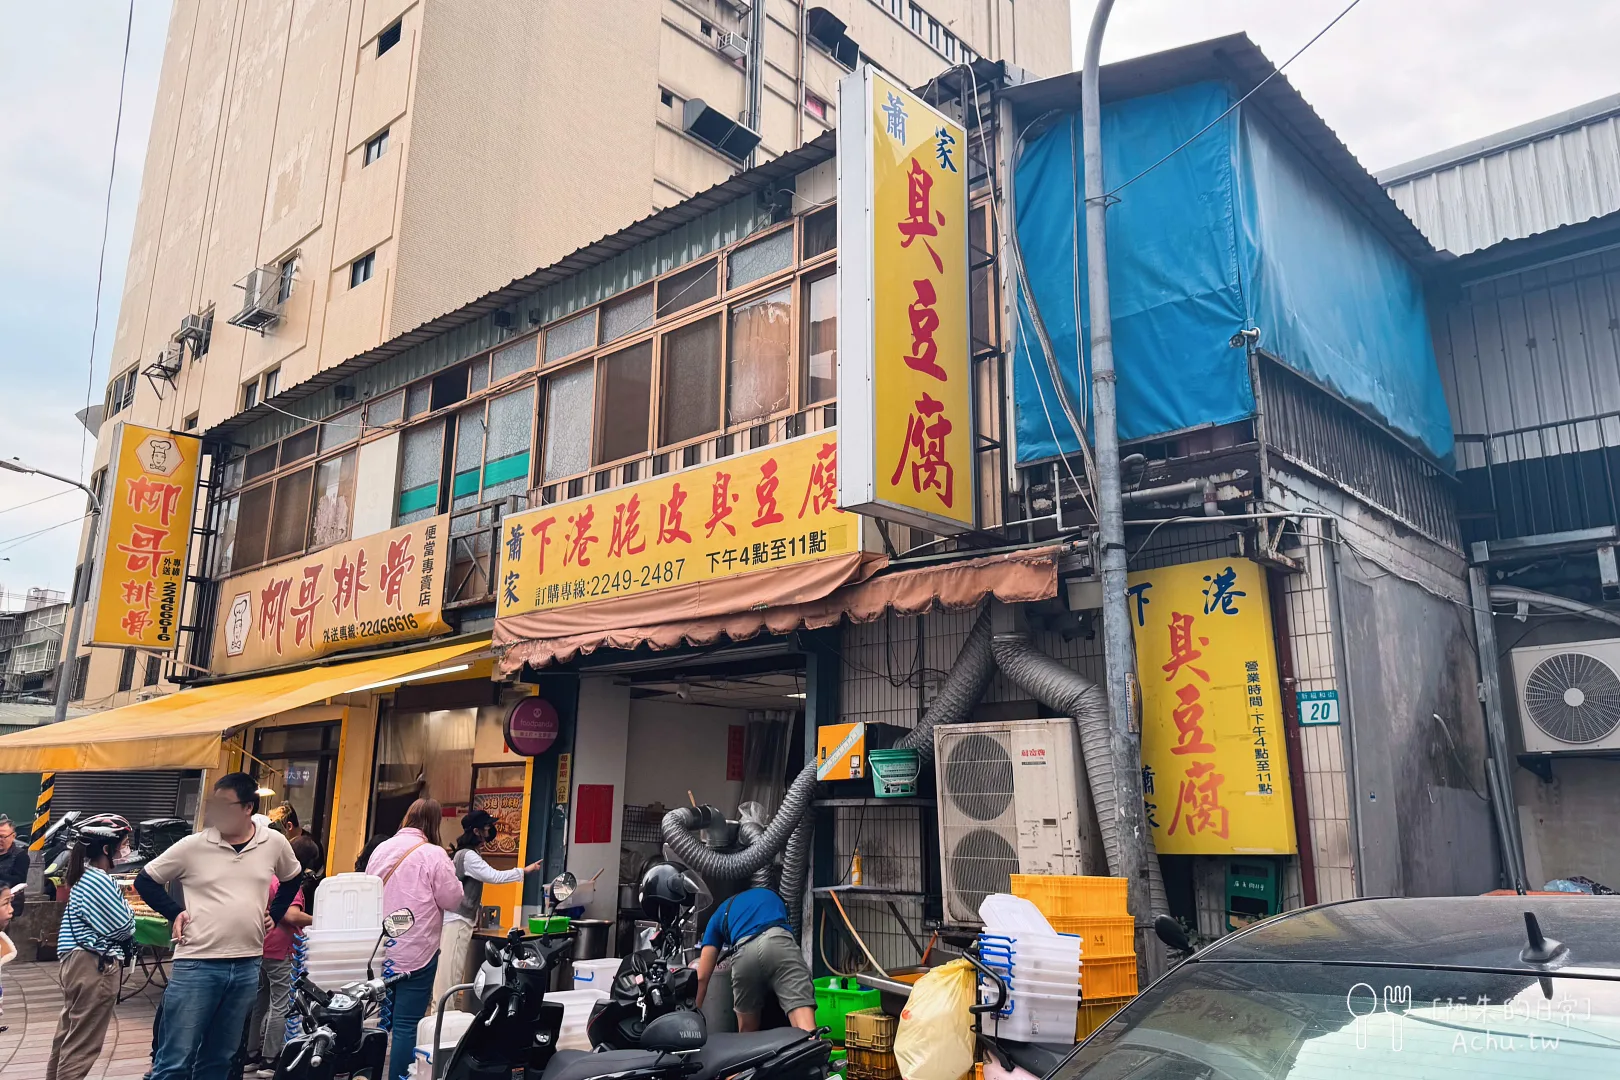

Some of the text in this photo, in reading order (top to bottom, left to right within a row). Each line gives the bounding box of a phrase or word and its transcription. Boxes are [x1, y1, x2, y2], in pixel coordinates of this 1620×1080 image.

[891, 157, 954, 509] 臭豆腐
[418, 524, 437, 607] 便當專賣店
[504, 524, 525, 608] 蕭家
[705, 530, 827, 574] 下午4點至11點
[1162, 611, 1230, 840] 臭豆腐
[1310, 702, 1331, 721] 20
